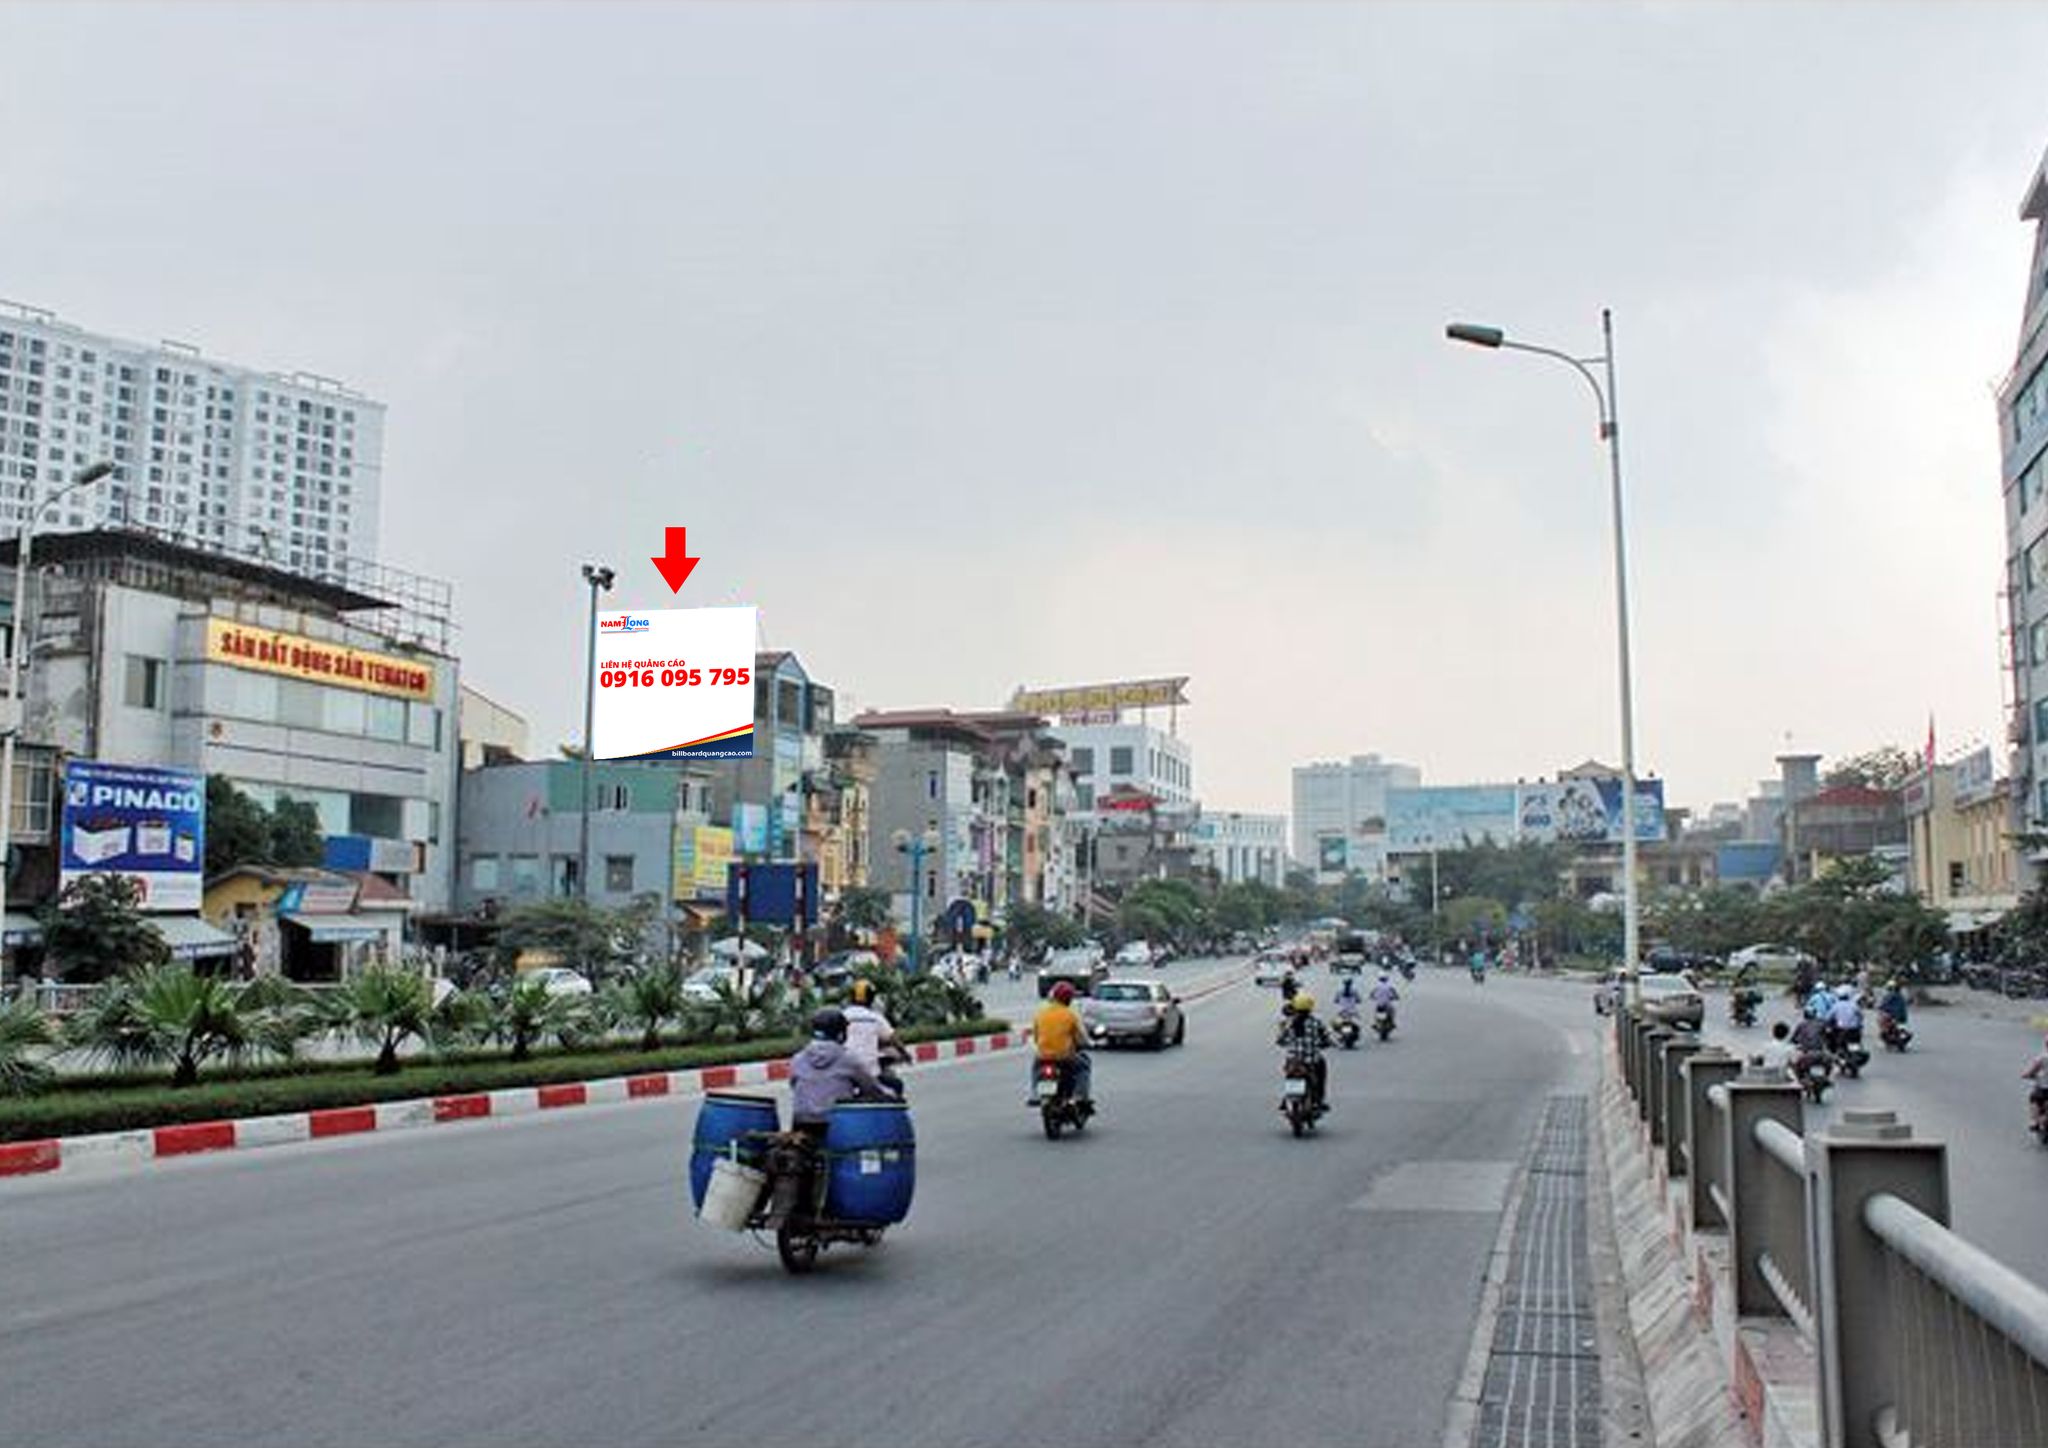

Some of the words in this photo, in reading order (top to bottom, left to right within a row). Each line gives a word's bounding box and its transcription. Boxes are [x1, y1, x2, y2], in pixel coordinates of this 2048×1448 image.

[601, 660, 619, 669] LIÊN
[621, 660, 632, 670] HỆ
[634, 658, 665, 669] QUẢNG
[667, 658, 685, 668] CÁO
[600, 669, 654, 688] 0916
[661, 669, 702, 687] 095
[708, 667, 750, 686] 795
[671, 750, 753, 758] billboardquangcao.com
[92, 785, 200, 812] PINACO
